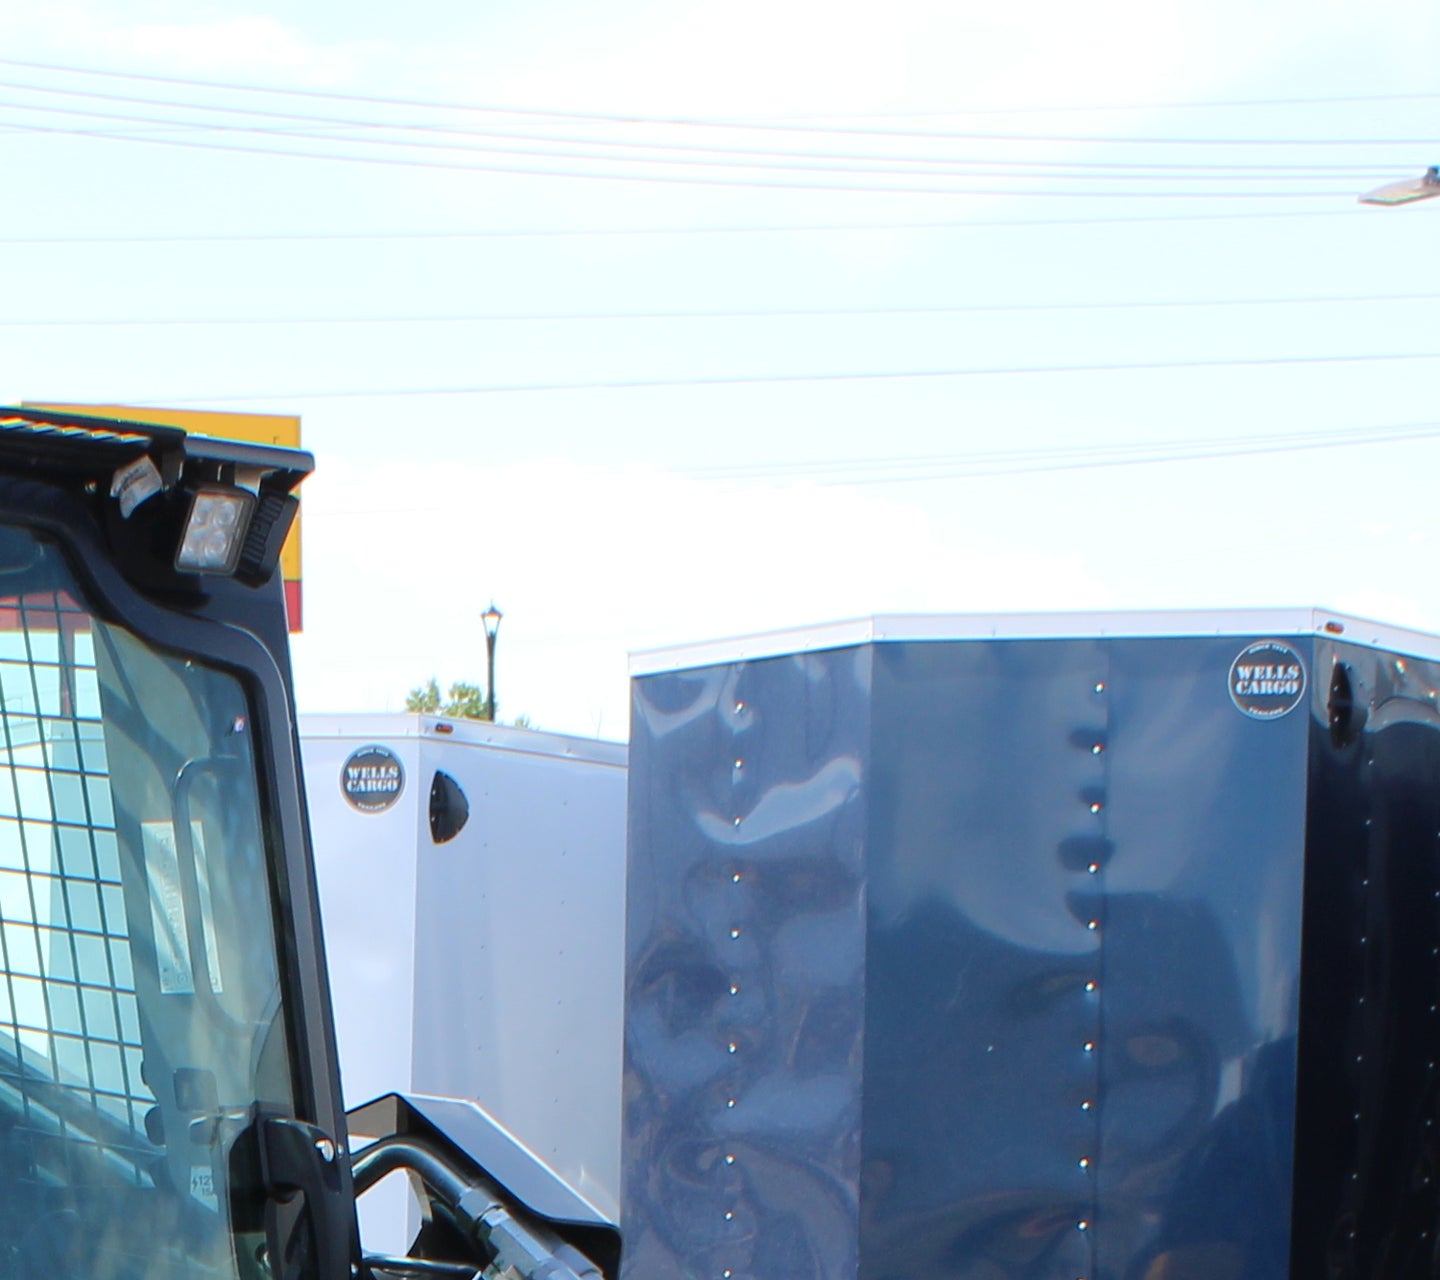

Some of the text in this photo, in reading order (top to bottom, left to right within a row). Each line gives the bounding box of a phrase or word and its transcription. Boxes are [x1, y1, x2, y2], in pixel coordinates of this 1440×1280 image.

[1236, 665, 1299, 680] WELLS
[1235, 680, 1299, 695] CARGO
[347, 766, 399, 779] WELLS
[346, 779, 399, 793] CARGO
